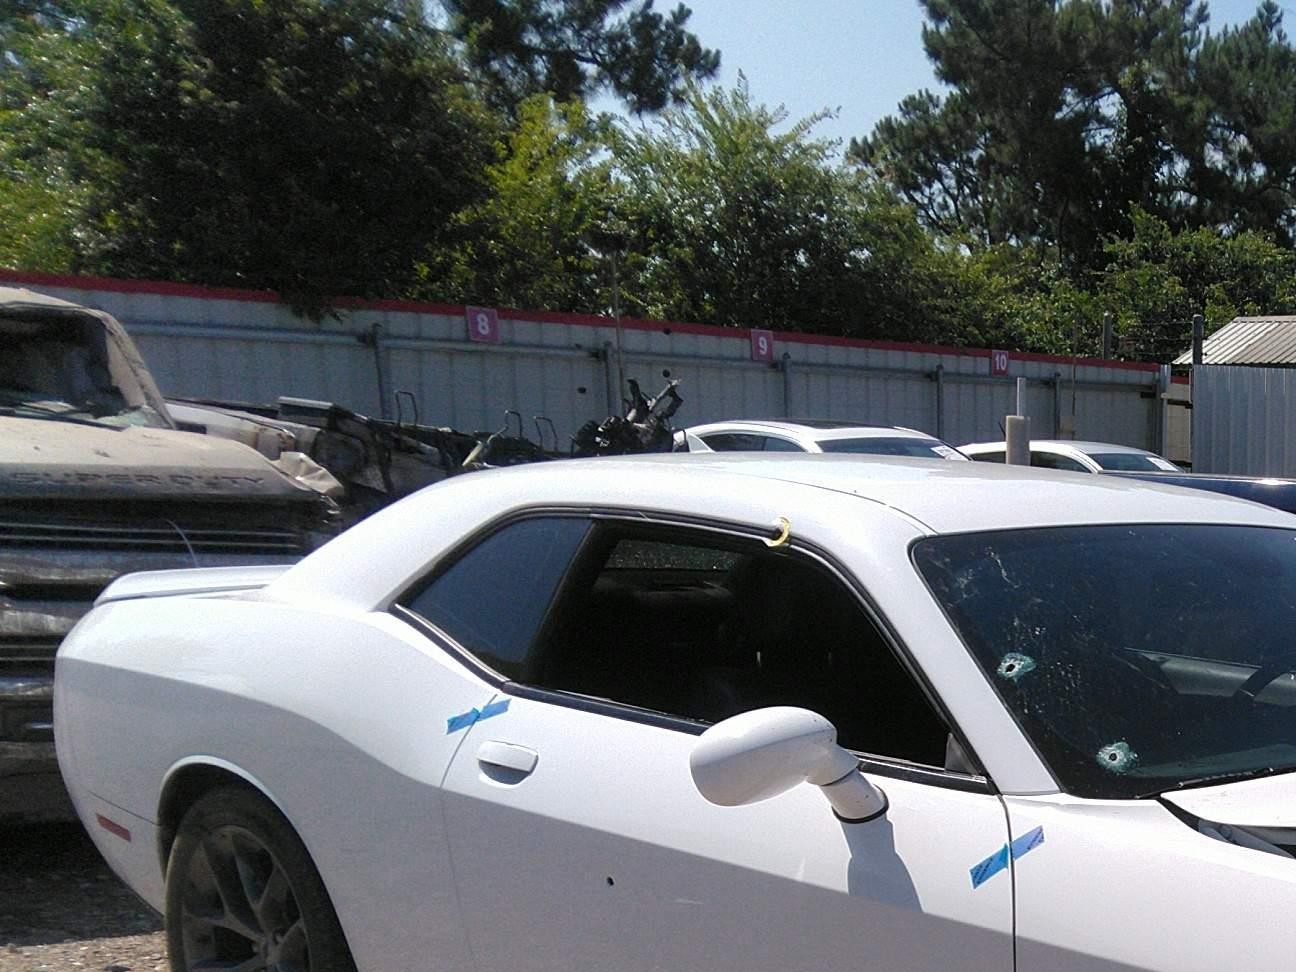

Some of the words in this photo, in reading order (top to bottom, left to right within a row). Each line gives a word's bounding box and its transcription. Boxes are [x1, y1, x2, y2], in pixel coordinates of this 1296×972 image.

[476, 313, 490, 336] 8
[758, 335, 768, 355] 9
[995, 354, 1007, 370] 10
